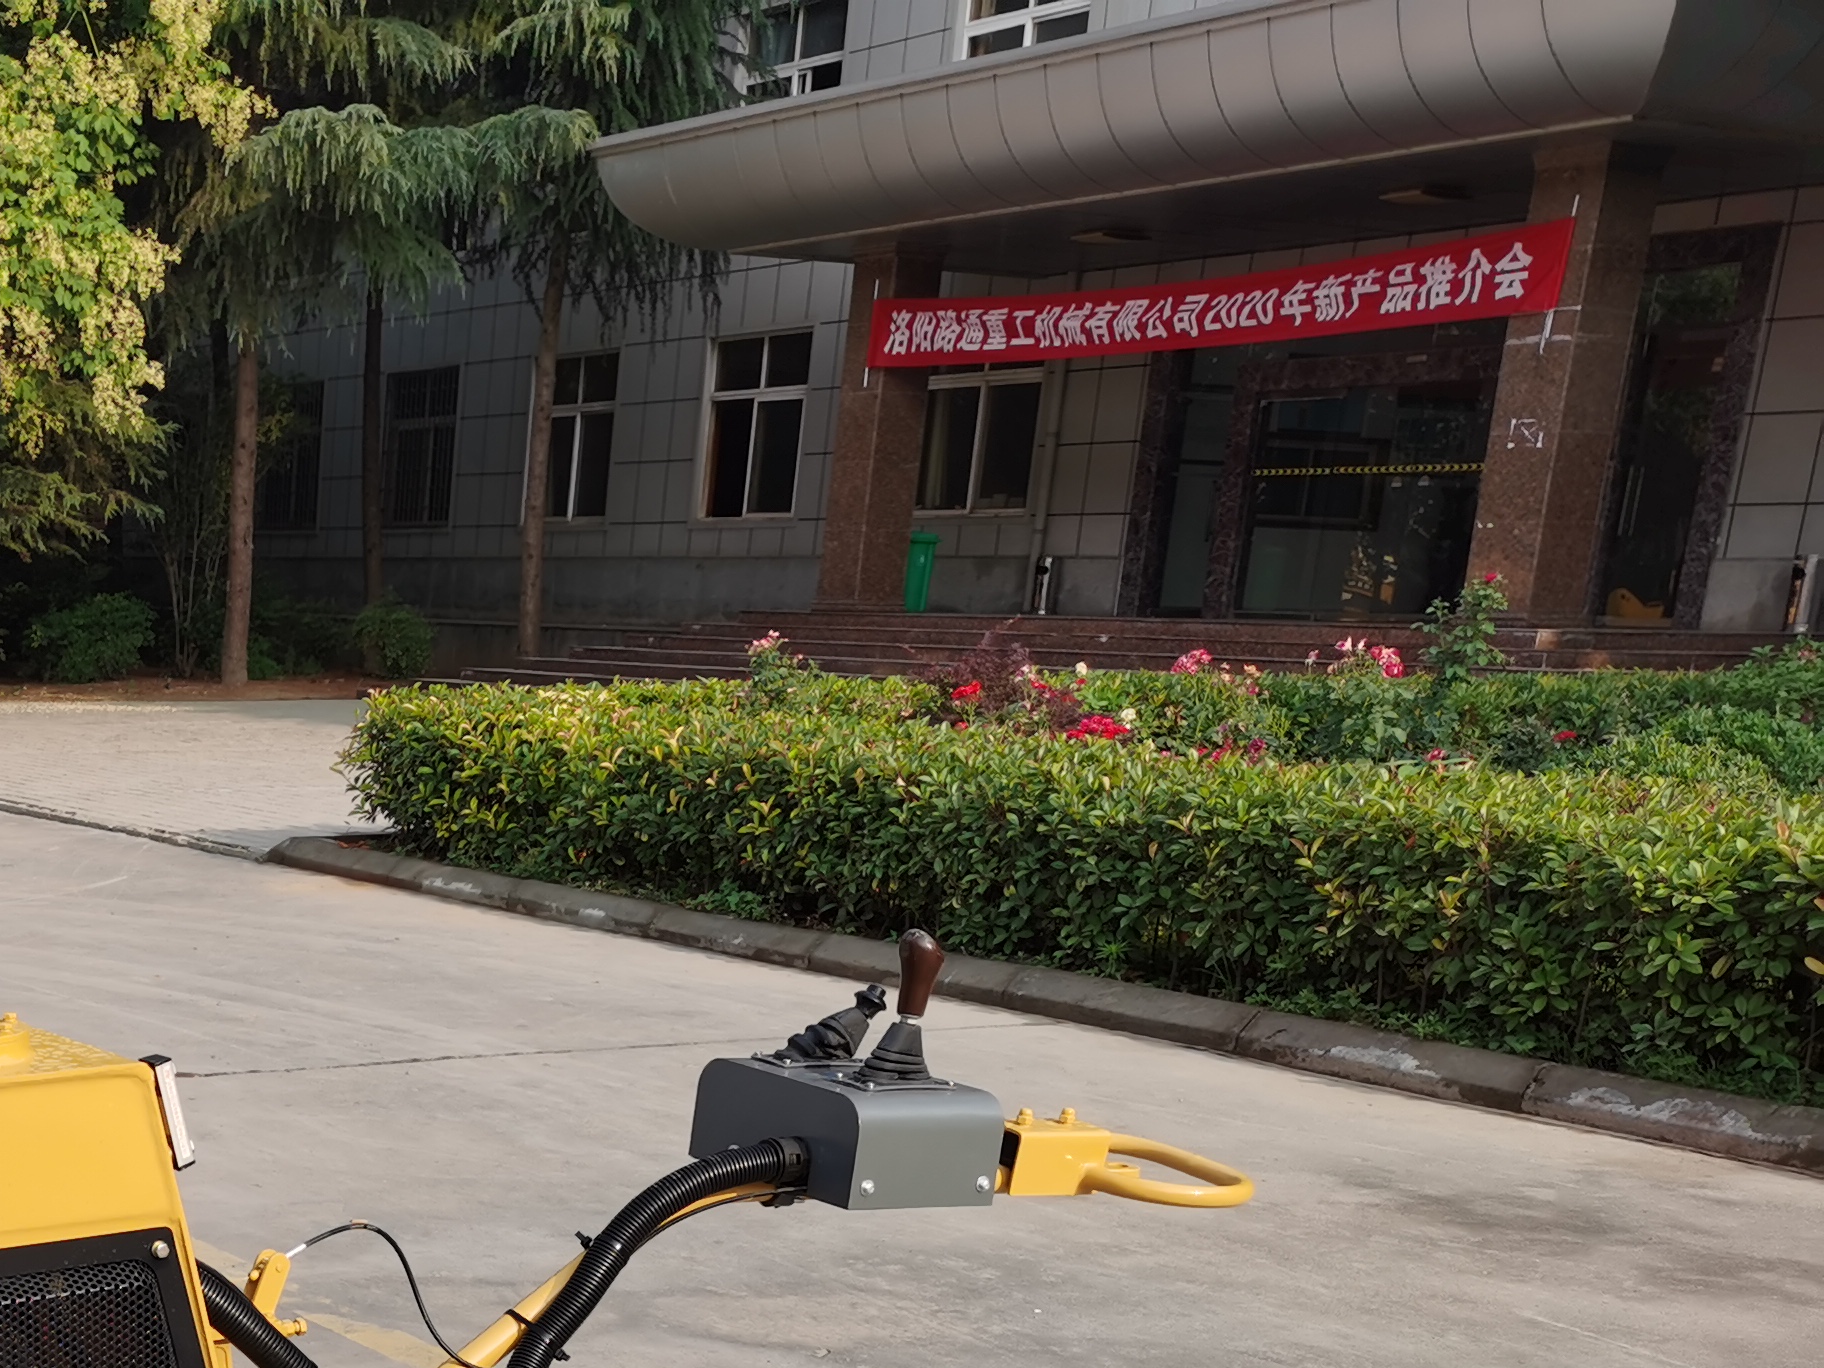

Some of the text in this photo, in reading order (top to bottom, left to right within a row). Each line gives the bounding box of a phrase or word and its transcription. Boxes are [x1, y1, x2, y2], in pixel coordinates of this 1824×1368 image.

[883, 242, 1533, 355] 洛阳路通重工机械有限公司2020年新产品推介会
